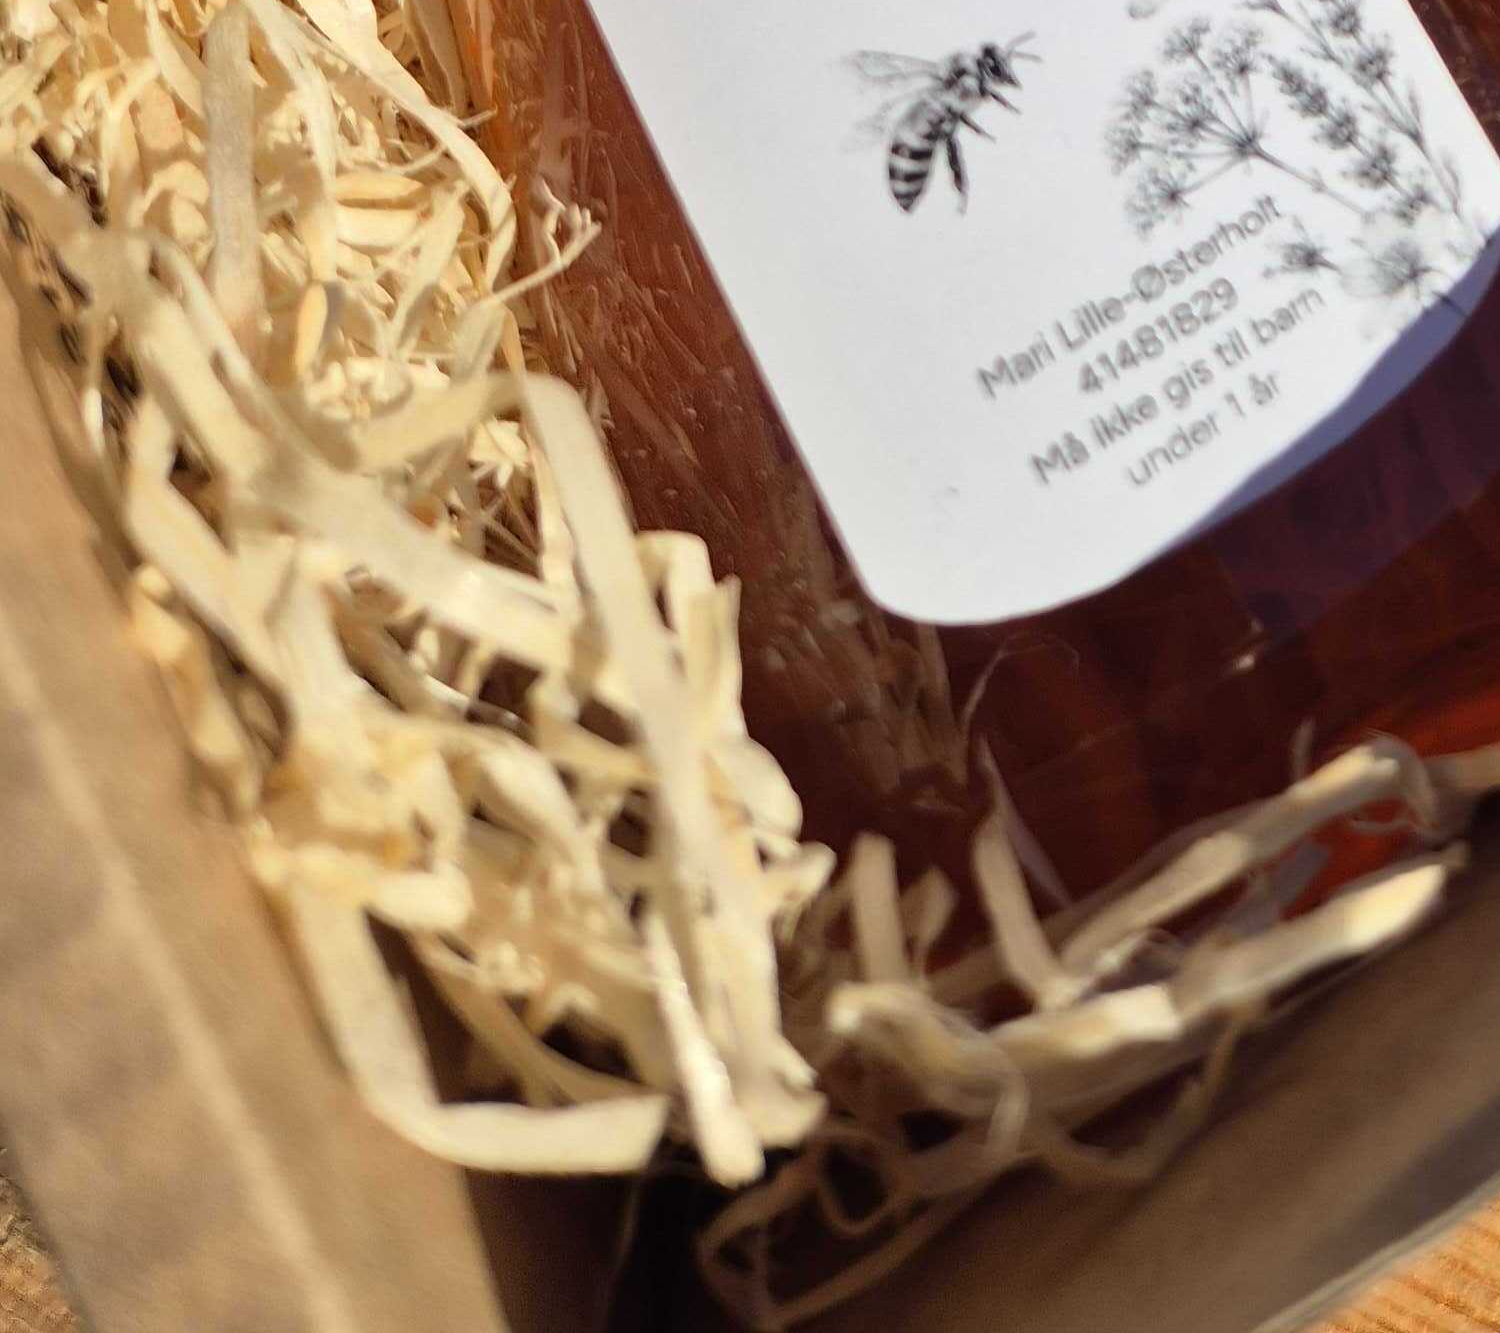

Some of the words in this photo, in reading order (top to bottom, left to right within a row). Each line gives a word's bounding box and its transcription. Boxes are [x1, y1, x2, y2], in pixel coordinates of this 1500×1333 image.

[977, 331, 1055, 399] Mari
[1031, 432, 1090, 484] Må
[1090, 395, 1159, 449] ikke
[1163, 360, 1213, 409] gis
[1213, 328, 1250, 367] til
[1250, 289, 1325, 345] barn
[1080, 277, 1238, 393] 41481829
[1129, 412, 1220, 485] under
[1225, 392, 1245, 418] 1
[1249, 373, 1280, 405] år
